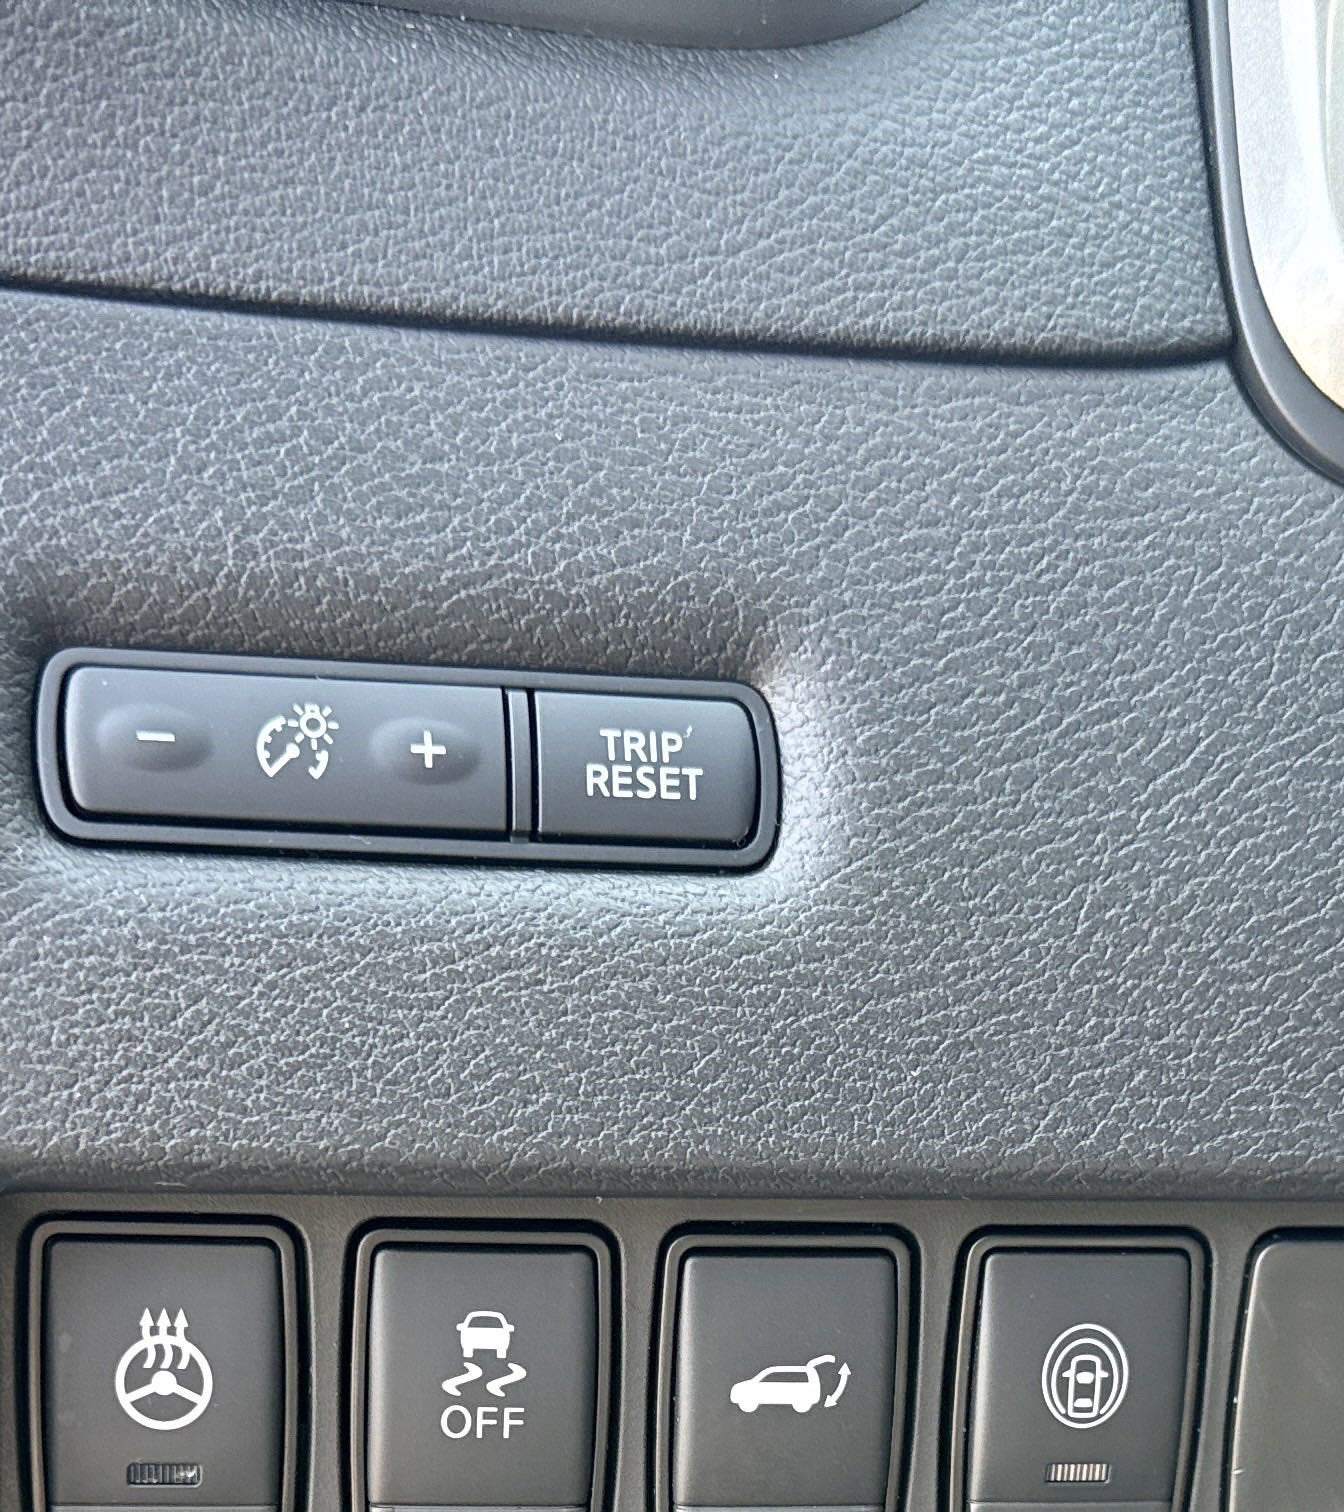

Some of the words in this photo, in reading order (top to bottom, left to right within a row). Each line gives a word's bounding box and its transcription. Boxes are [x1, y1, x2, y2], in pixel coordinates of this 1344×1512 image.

[599, 727, 685, 764] TRIP
[585, 762, 704, 801] RESET
[440, 1404, 525, 1440] OFF
